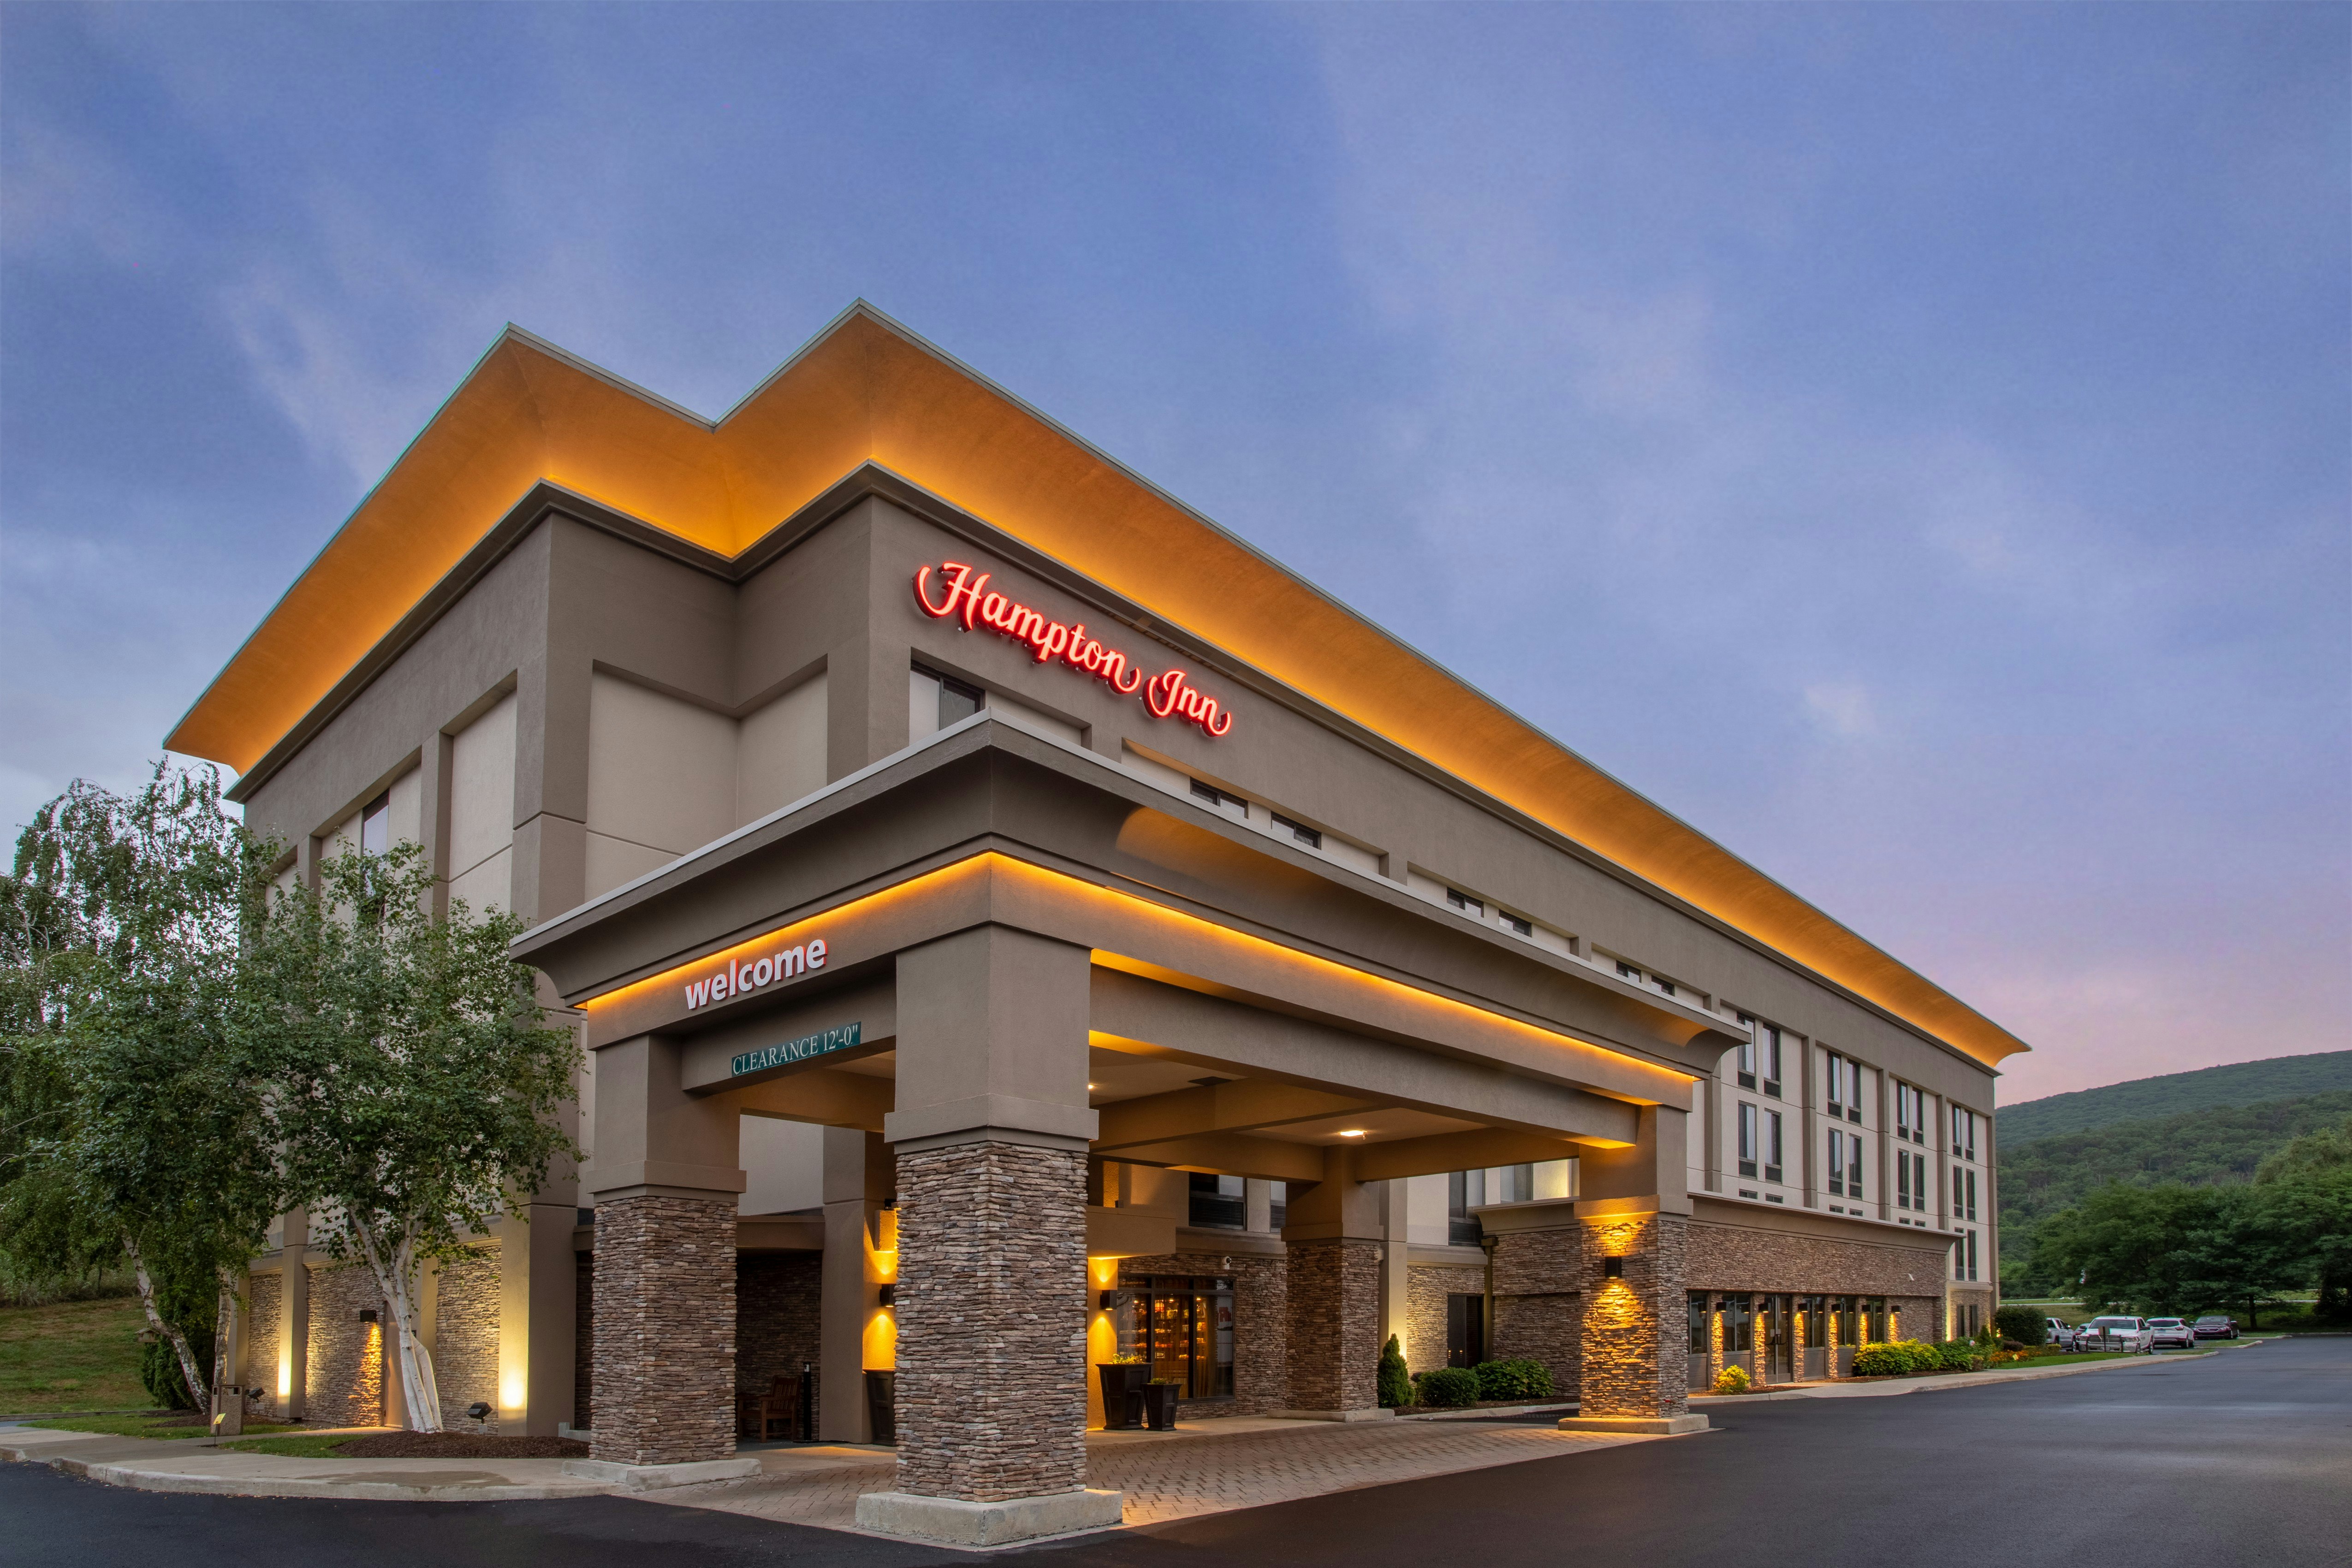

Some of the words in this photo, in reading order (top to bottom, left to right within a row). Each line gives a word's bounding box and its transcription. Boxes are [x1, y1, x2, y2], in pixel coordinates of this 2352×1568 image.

[913, 561, 1140, 694] Hampton
[1142, 670, 1231, 737] Inn
[685, 939, 827, 1010] welcome
[733, 1036, 818, 1075] CLEARANCE
